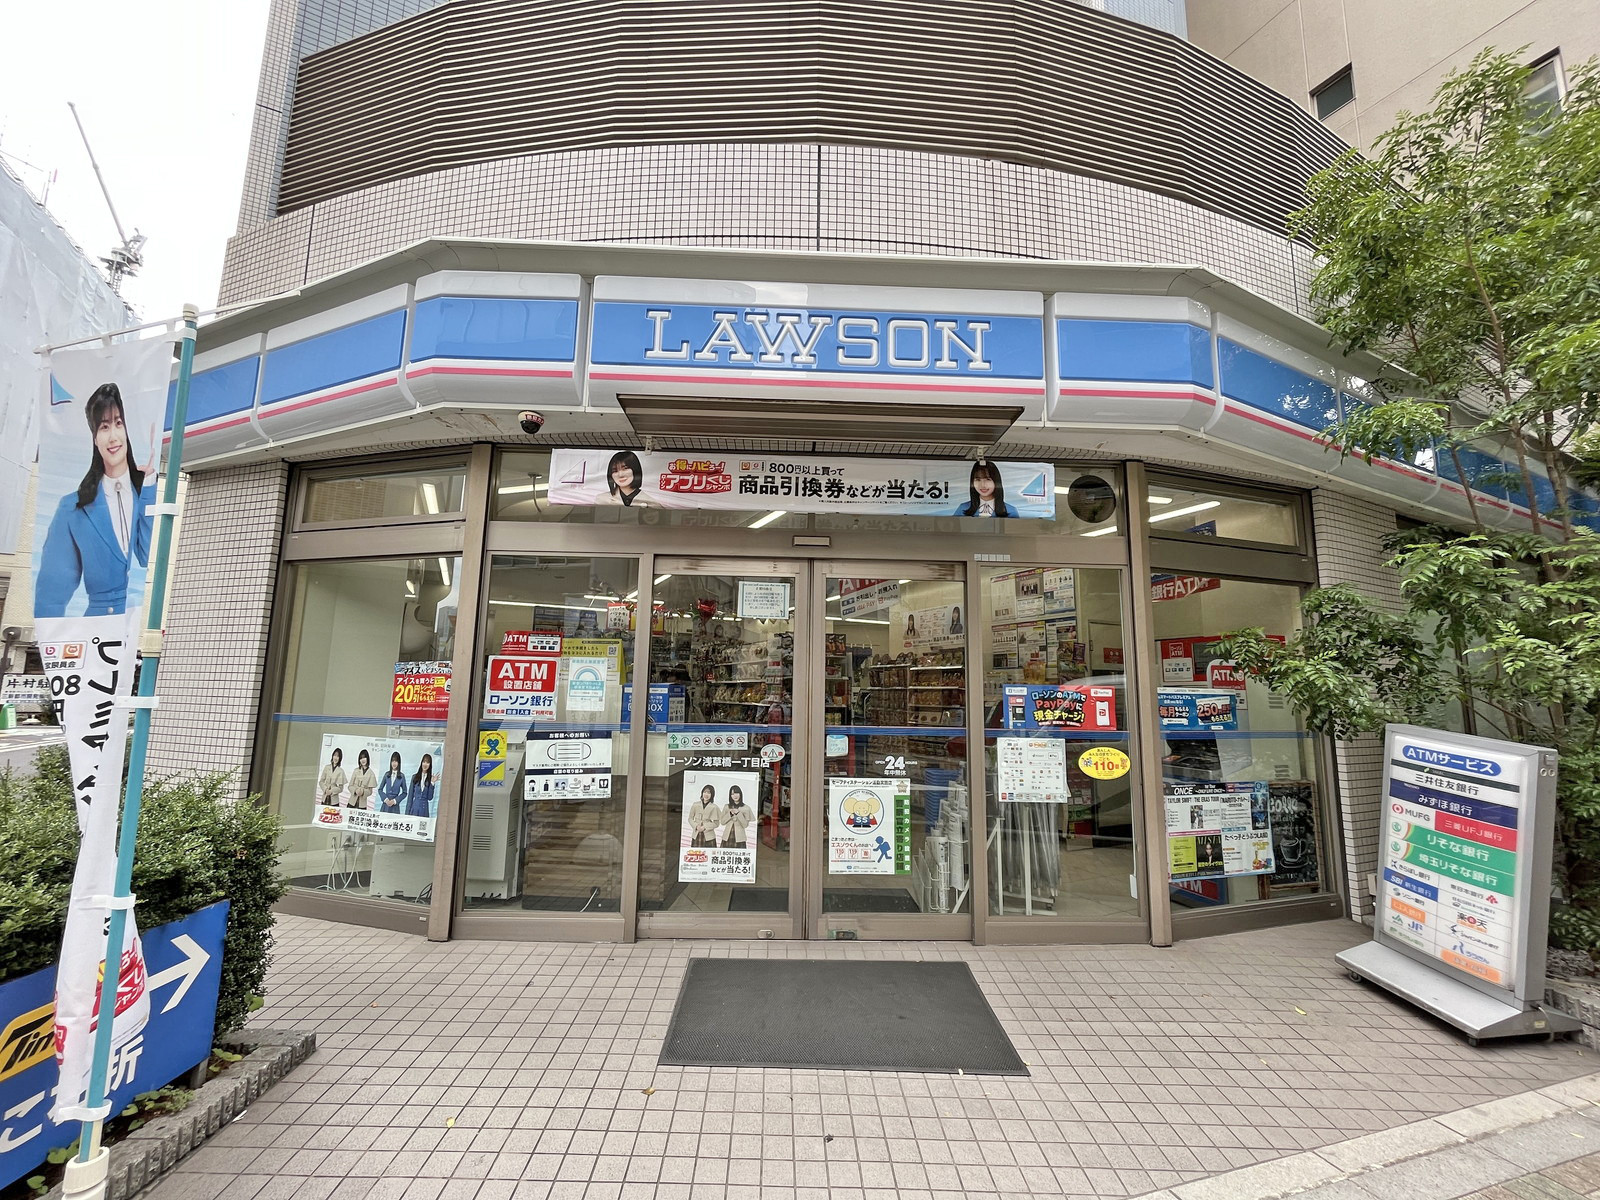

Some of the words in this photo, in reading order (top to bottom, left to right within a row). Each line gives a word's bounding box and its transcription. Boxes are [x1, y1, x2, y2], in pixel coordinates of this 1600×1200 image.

[644, 309, 992, 371] LAWSON
[769, 462, 845, 476] 800円以上買って
[739, 475, 949, 499] 商品引換券などが当たる!
[507, 634, 527, 643] ATM
[498, 662, 548, 680] ATM
[503, 681, 543, 691] 設置店舗
[394, 685, 414, 703] 20
[1032, 690, 1087, 701] ローソンのATMで
[489, 695, 554, 707] ローソン銀行
[1036, 699, 1083, 711] PayPayに
[1033, 709, 1085, 722] 現金チャージ!
[1160, 706, 1175, 717] 毎月
[666, 756, 770, 768] ローソン浅草橋一丁目店
[884, 755, 906, 770] 24
[1406, 747, 1495, 775] ATMサービス
[1415, 773, 1479, 796] 三井住友銀行
[1173, 787, 1193, 796] ONCE
[1418, 795, 1473, 816] みずほ銀行
[856, 816, 868, 824] SS
[1405, 808, 1431, 822] MUFG
[1444, 819, 1503, 842] 三菱UFJ銀行
[1427, 834, 1490, 861] りそな銀行
[711, 855, 751, 866] 商品引換券
[711, 865, 751, 874] などが当たる!
[1419, 853, 1498, 886] 埼玉りそな銀行
[1390, 875, 1404, 885] SBI
